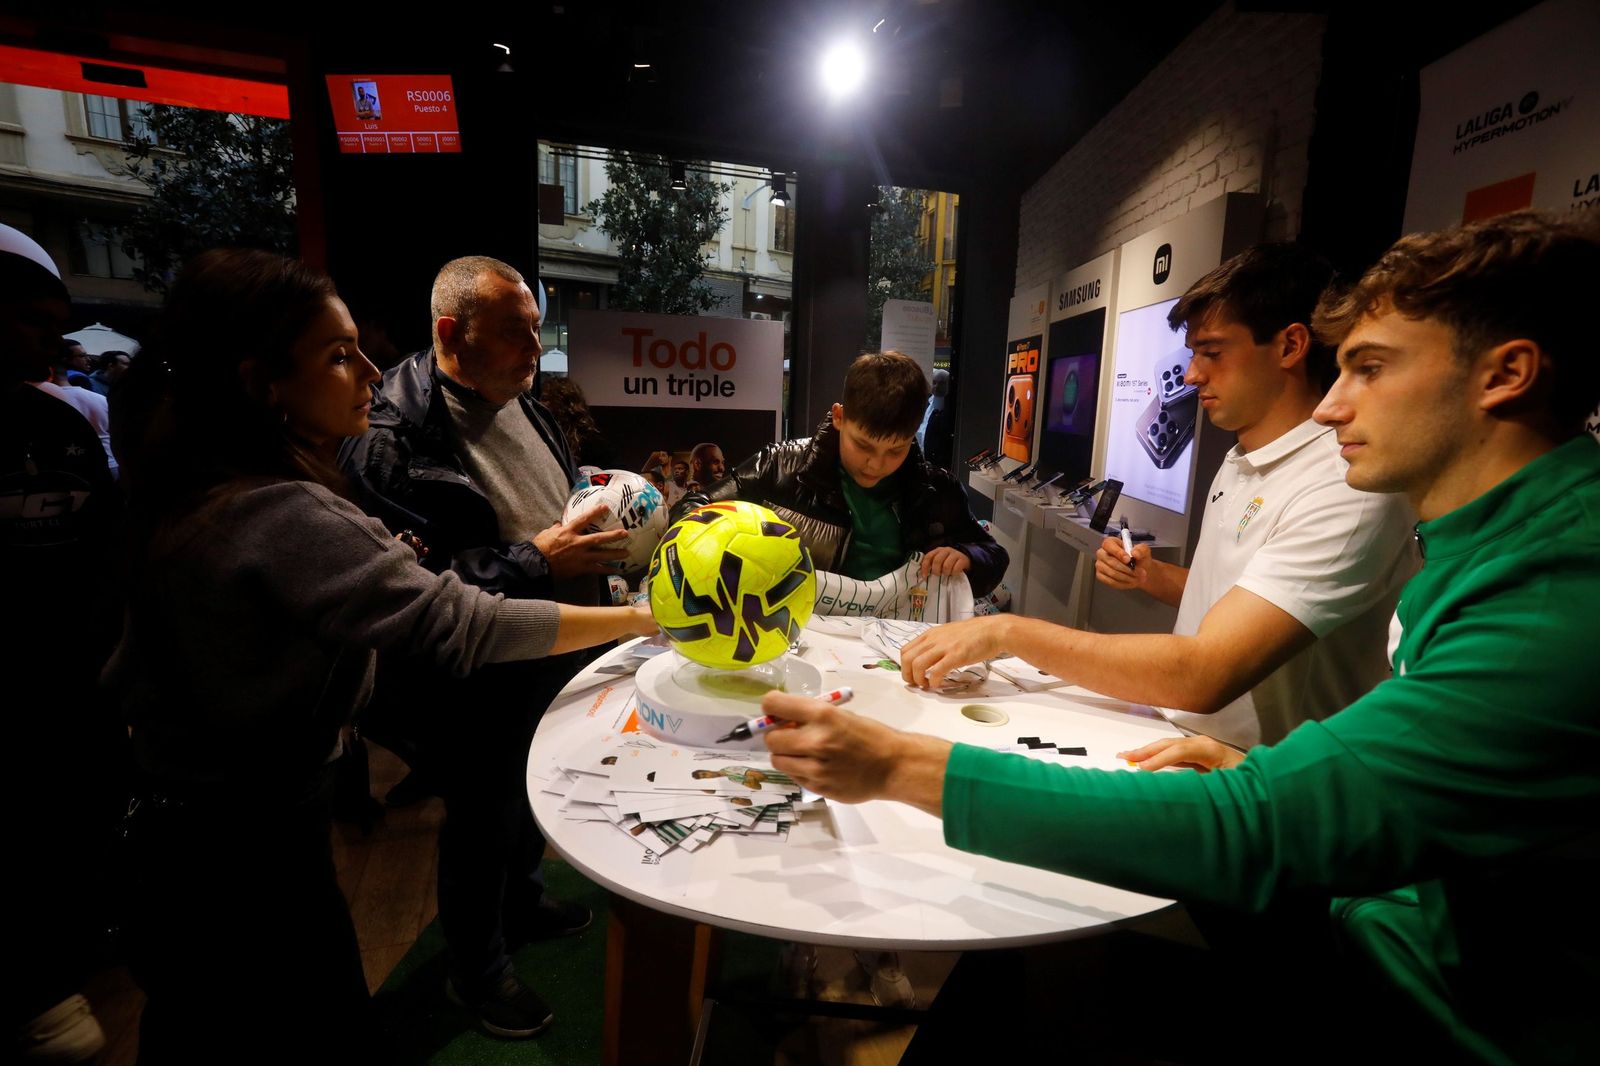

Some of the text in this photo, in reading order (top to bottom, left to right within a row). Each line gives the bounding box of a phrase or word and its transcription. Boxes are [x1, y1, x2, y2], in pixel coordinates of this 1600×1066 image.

[406, 90, 451, 101] RS0006
[414, 104, 447, 112] Puesto 4
[1455, 102, 1513, 140] LALIGA
[1058, 278, 1101, 311] SAMSUNG
[621, 327, 737, 372] Todo
[1008, 350, 1038, 374] PRO
[624, 373, 736, 401] un triple
